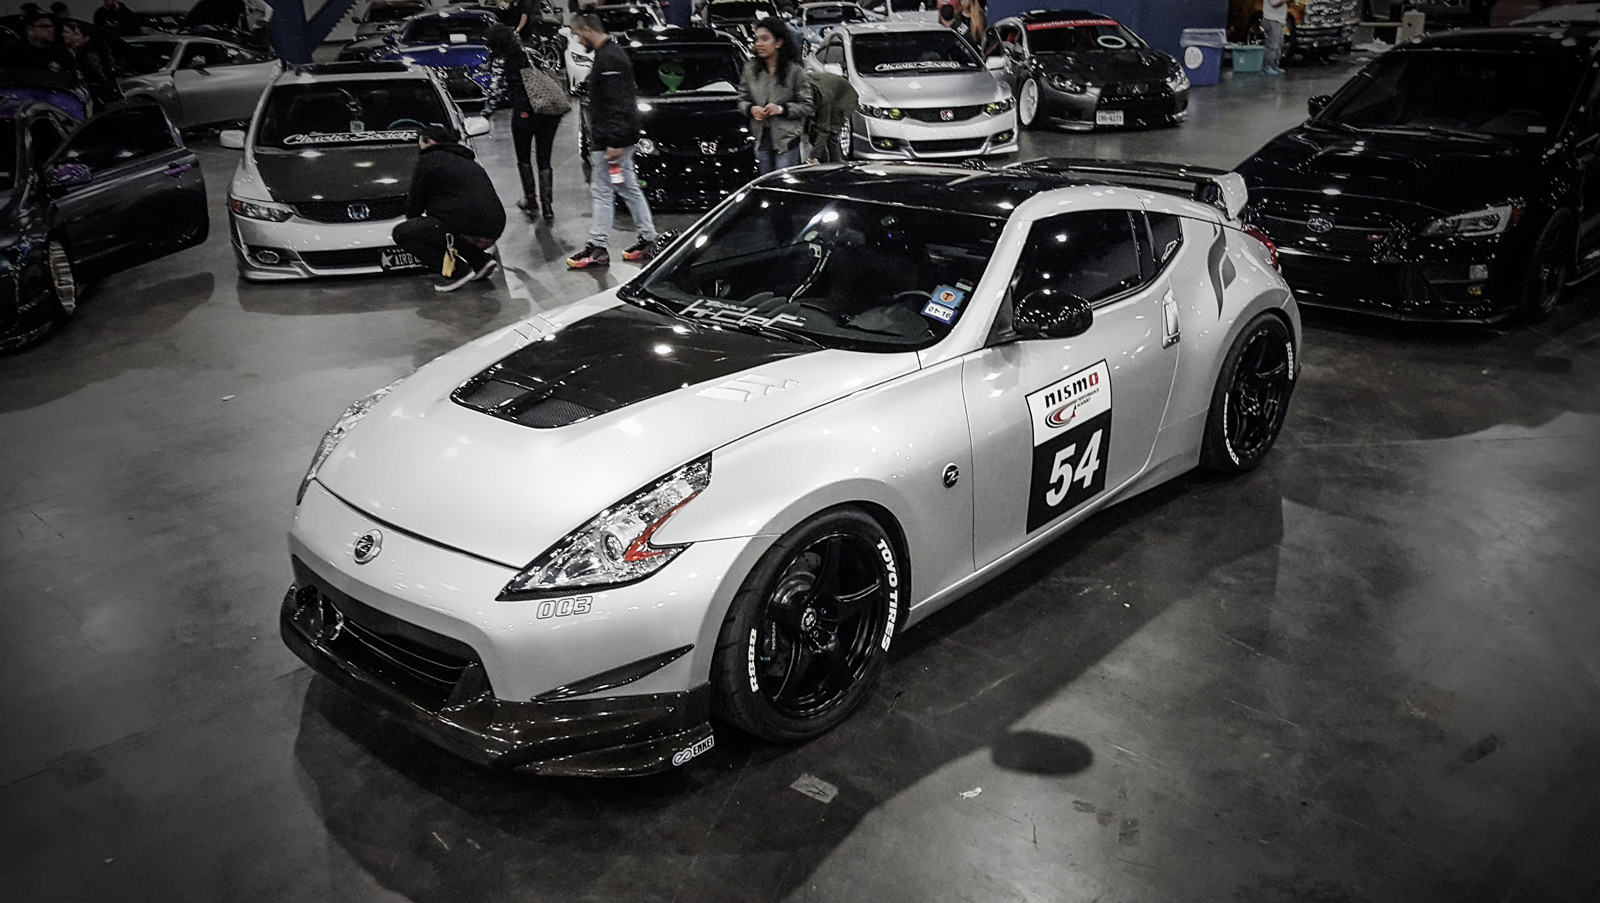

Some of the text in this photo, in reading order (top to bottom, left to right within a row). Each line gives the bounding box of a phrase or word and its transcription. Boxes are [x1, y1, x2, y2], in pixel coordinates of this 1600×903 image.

[1046, 428, 1103, 507] 54
[536, 595, 594, 620] 003
[877, 538, 898, 653] TOYO TIRES
[693, 737, 713, 755] ENKEI
